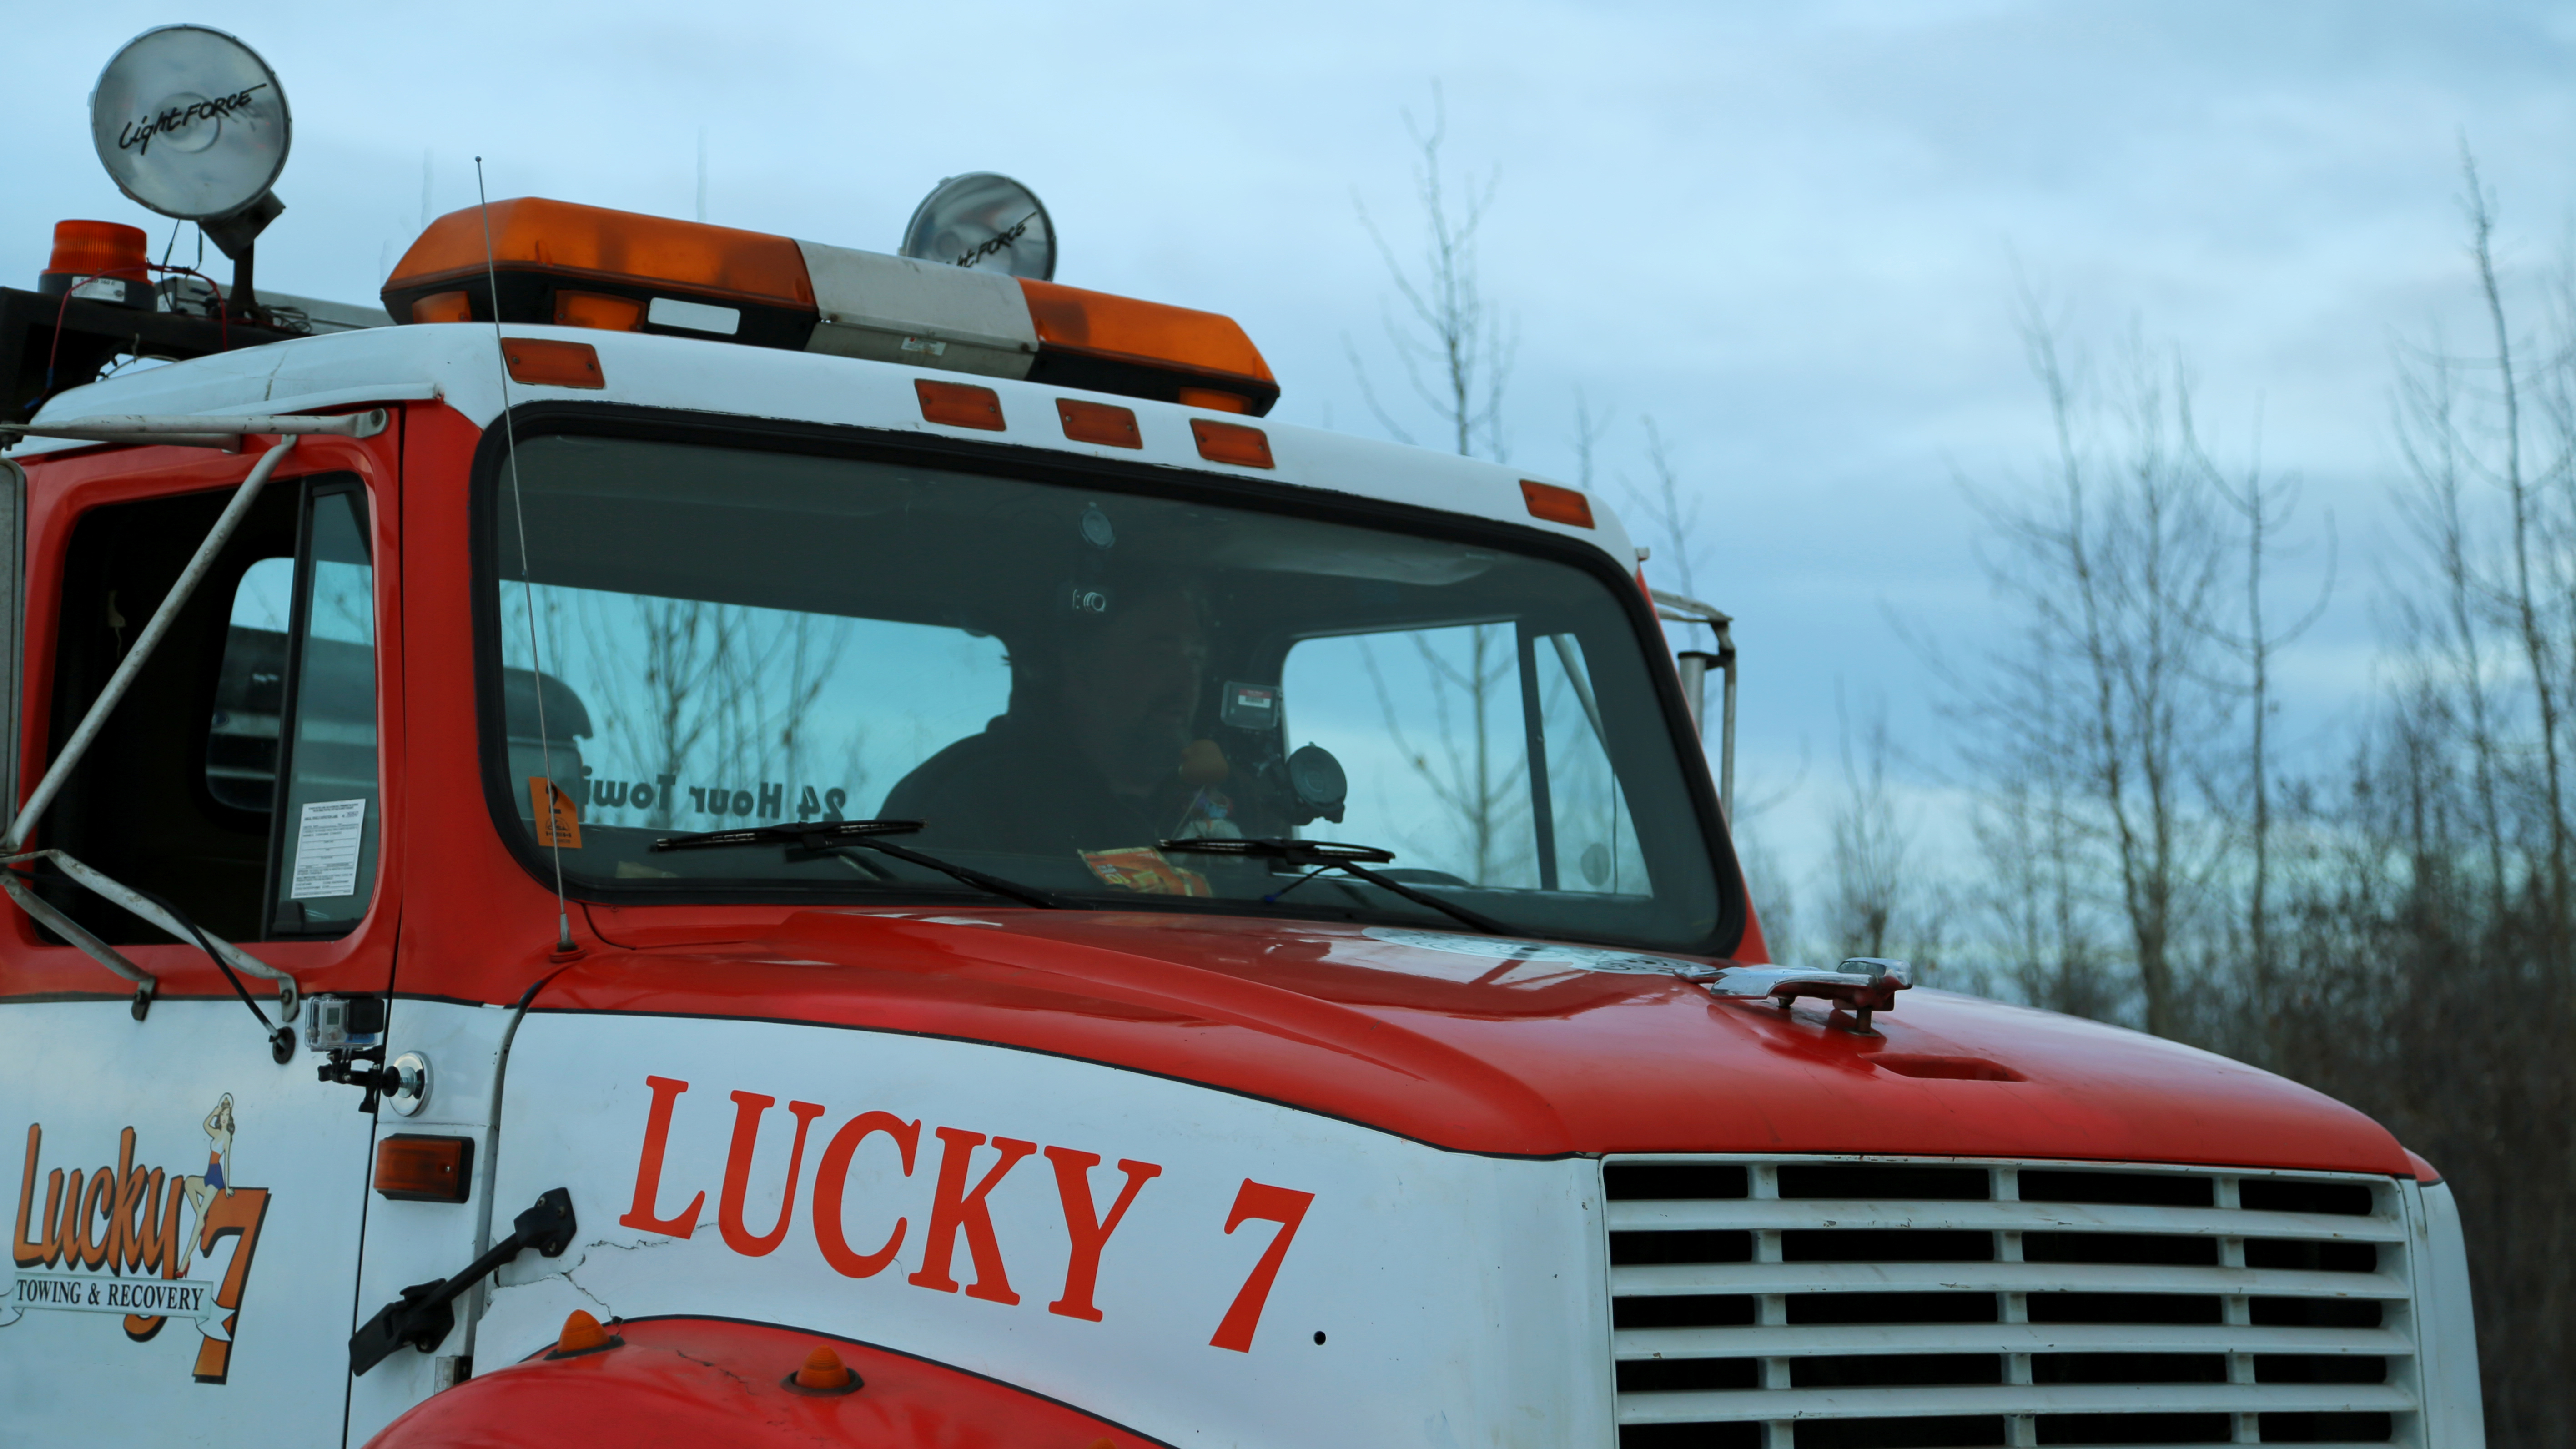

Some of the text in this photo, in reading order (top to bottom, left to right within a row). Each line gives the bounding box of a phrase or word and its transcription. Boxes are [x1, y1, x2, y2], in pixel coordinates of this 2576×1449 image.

[956, 210, 1037, 268] htFORCE
[13, 1122, 272, 1385] Lucky 7
[619, 1075, 1315, 1354] LUCKY 7
[16, 1279, 205, 1311] TOWING & RECOVERY
